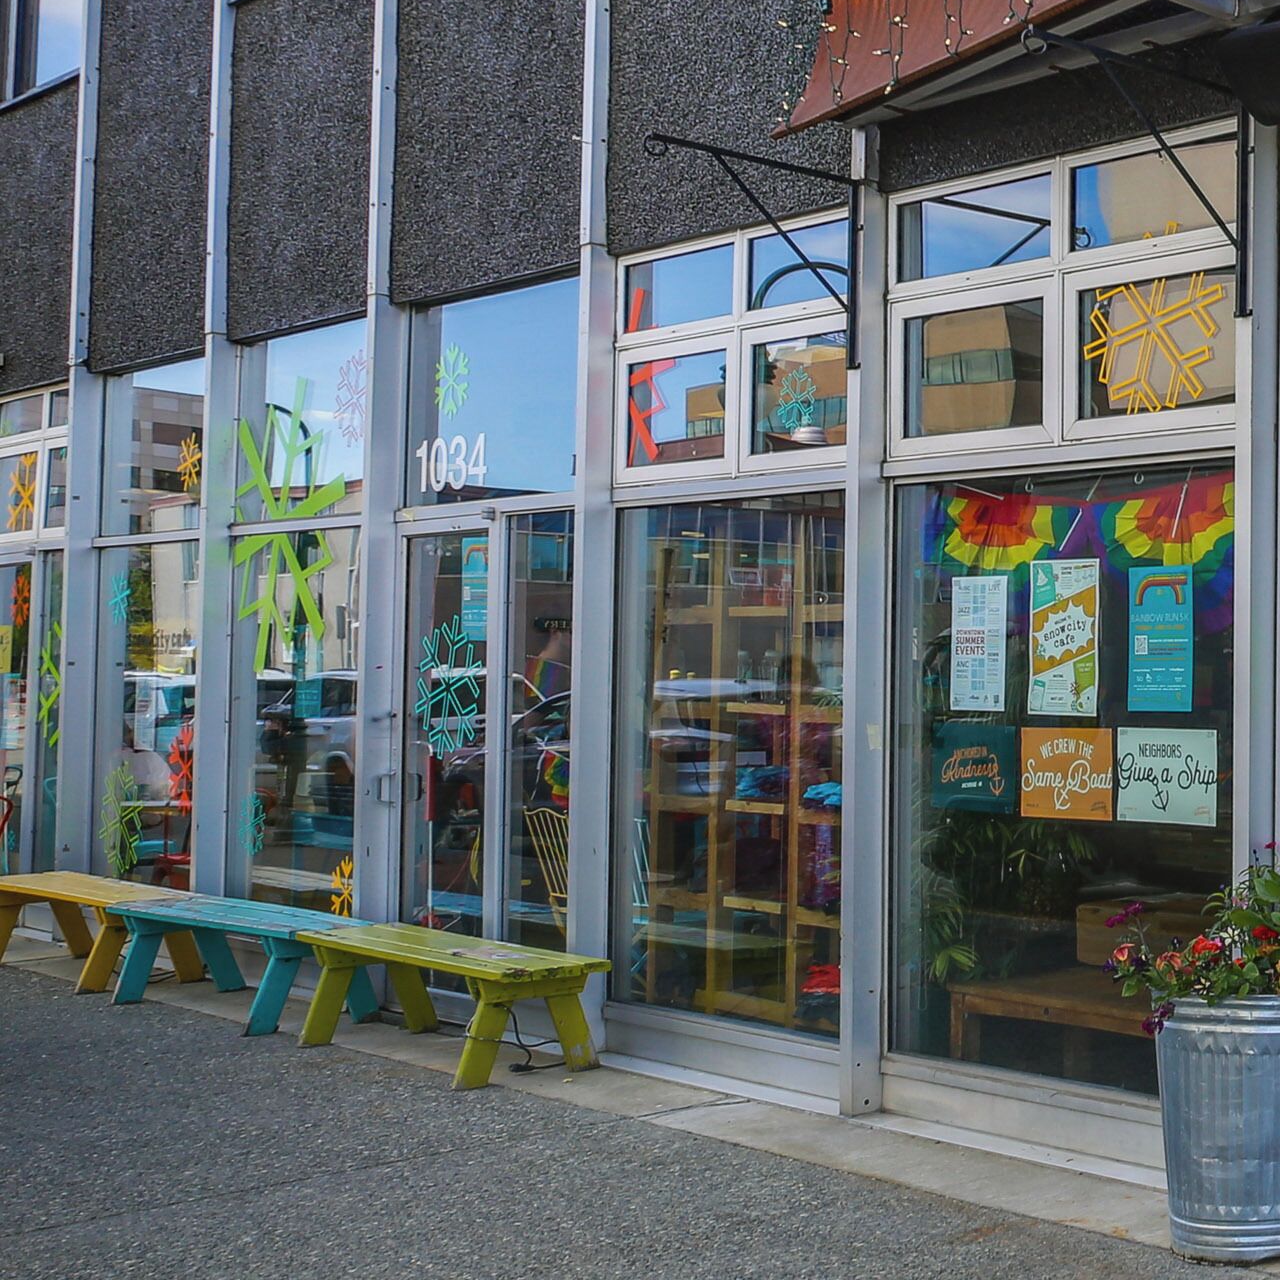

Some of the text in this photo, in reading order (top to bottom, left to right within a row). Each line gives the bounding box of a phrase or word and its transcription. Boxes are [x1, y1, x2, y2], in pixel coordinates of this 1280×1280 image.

[416, 432, 487, 493] 1034
[955, 636, 985, 645] SUMMER
[1053, 633, 1076, 649] cafe
[955, 646, 985, 656] EVENTS
[1040, 738, 1095, 760] WE CREW THE
[1138, 743, 1183, 759] NEIGHBORS
[1021, 758, 1113, 794] Same Boat
[1117, 752, 1218, 794] Give a Ship
